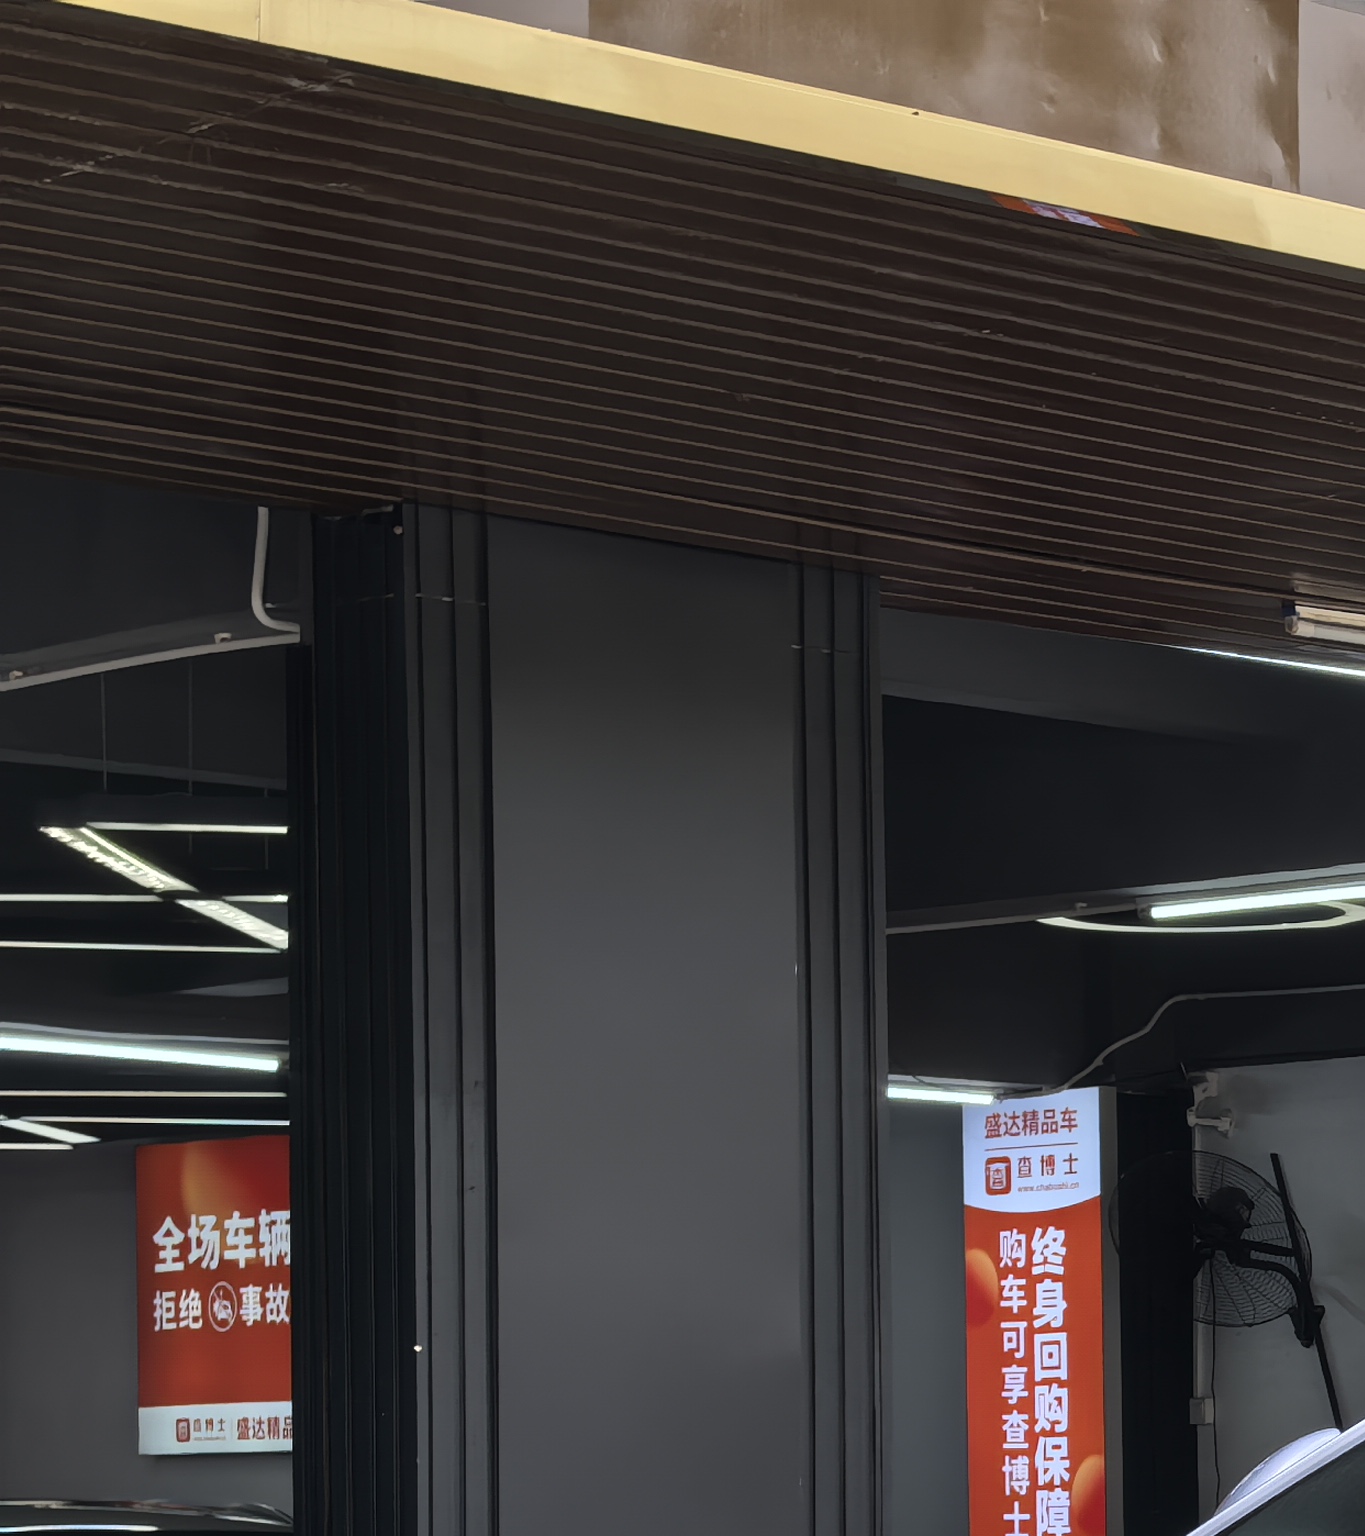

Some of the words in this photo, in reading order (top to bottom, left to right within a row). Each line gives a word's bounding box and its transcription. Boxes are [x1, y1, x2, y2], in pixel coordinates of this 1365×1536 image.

[984, 1106, 1079, 1139] 盛达精品车
[1016, 1152, 1079, 1179] 查博士
[152, 1208, 291, 1274] 全场车辆
[153, 1288, 203, 1333] 拒绝
[239, 1282, 291, 1327] 事故
